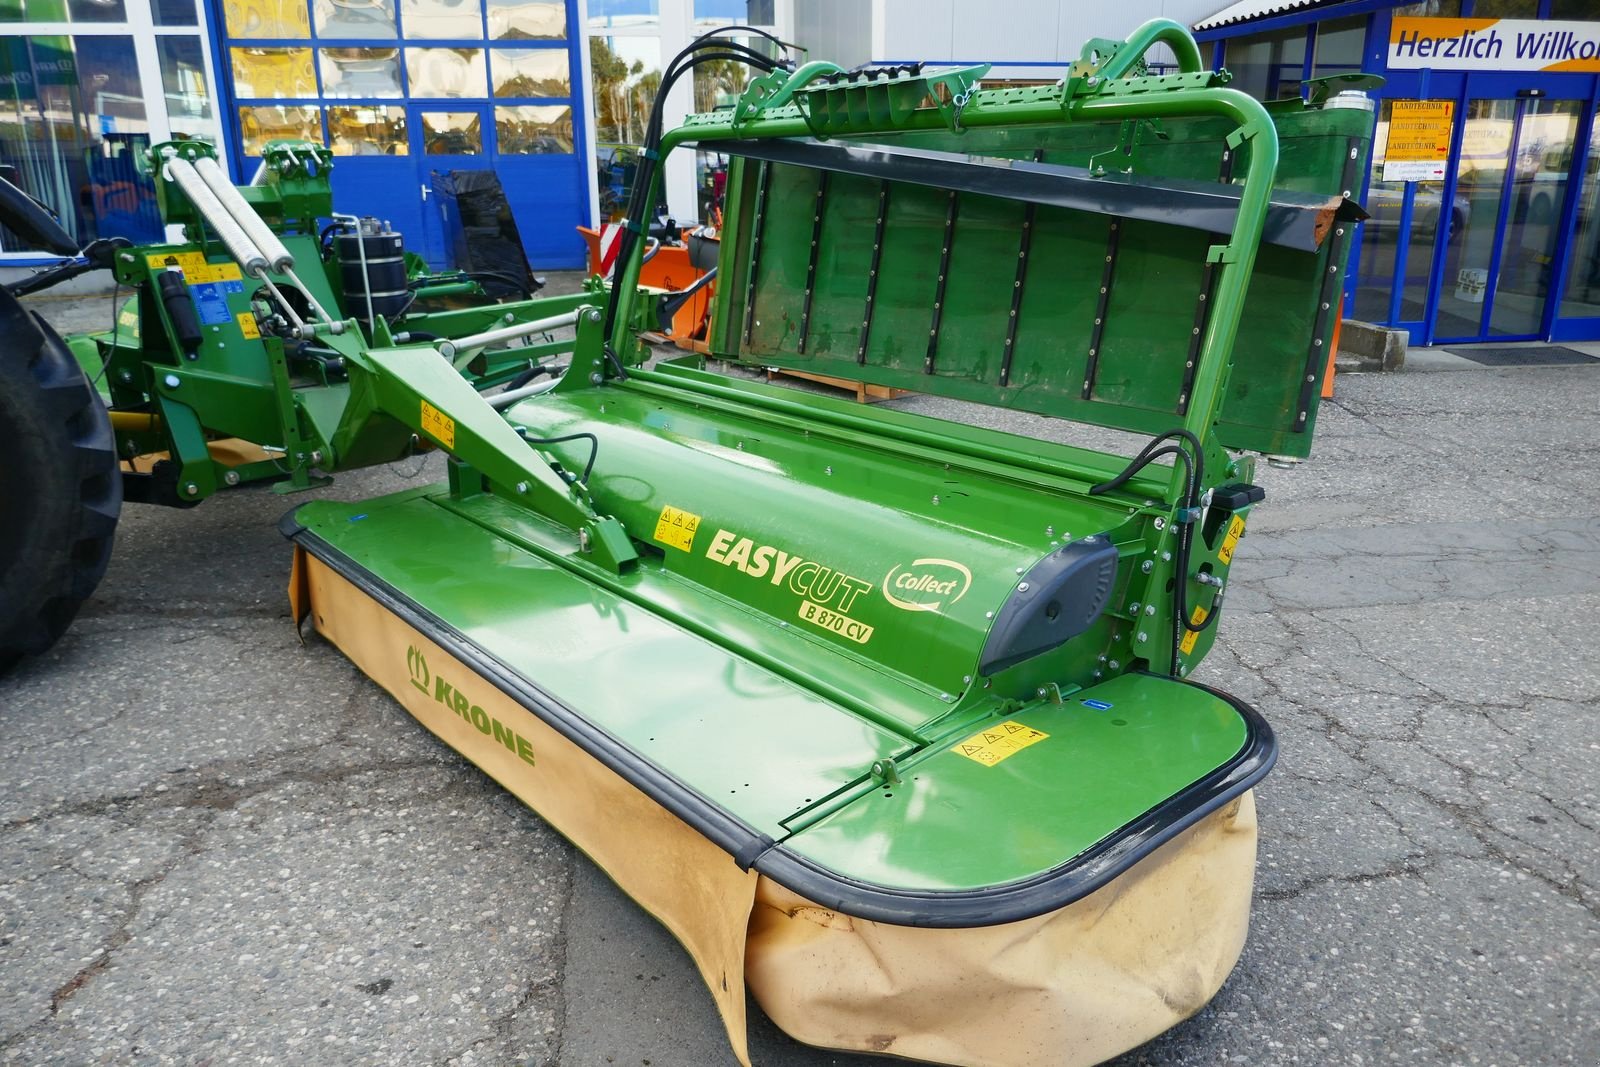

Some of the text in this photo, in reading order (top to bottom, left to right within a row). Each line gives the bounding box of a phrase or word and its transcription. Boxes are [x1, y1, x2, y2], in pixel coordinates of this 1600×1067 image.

[1396, 29, 1600, 60] Herzlich Willko
[1394, 102, 1443, 110] LANDTECHNIK
[1388, 142, 1436, 150] LANDTECHNIK
[705, 529, 873, 613] EASYCUT
[895, 572, 958, 595] Collect
[805, 604, 868, 641] B 870 CV
[435, 675, 536, 767] KRONE
